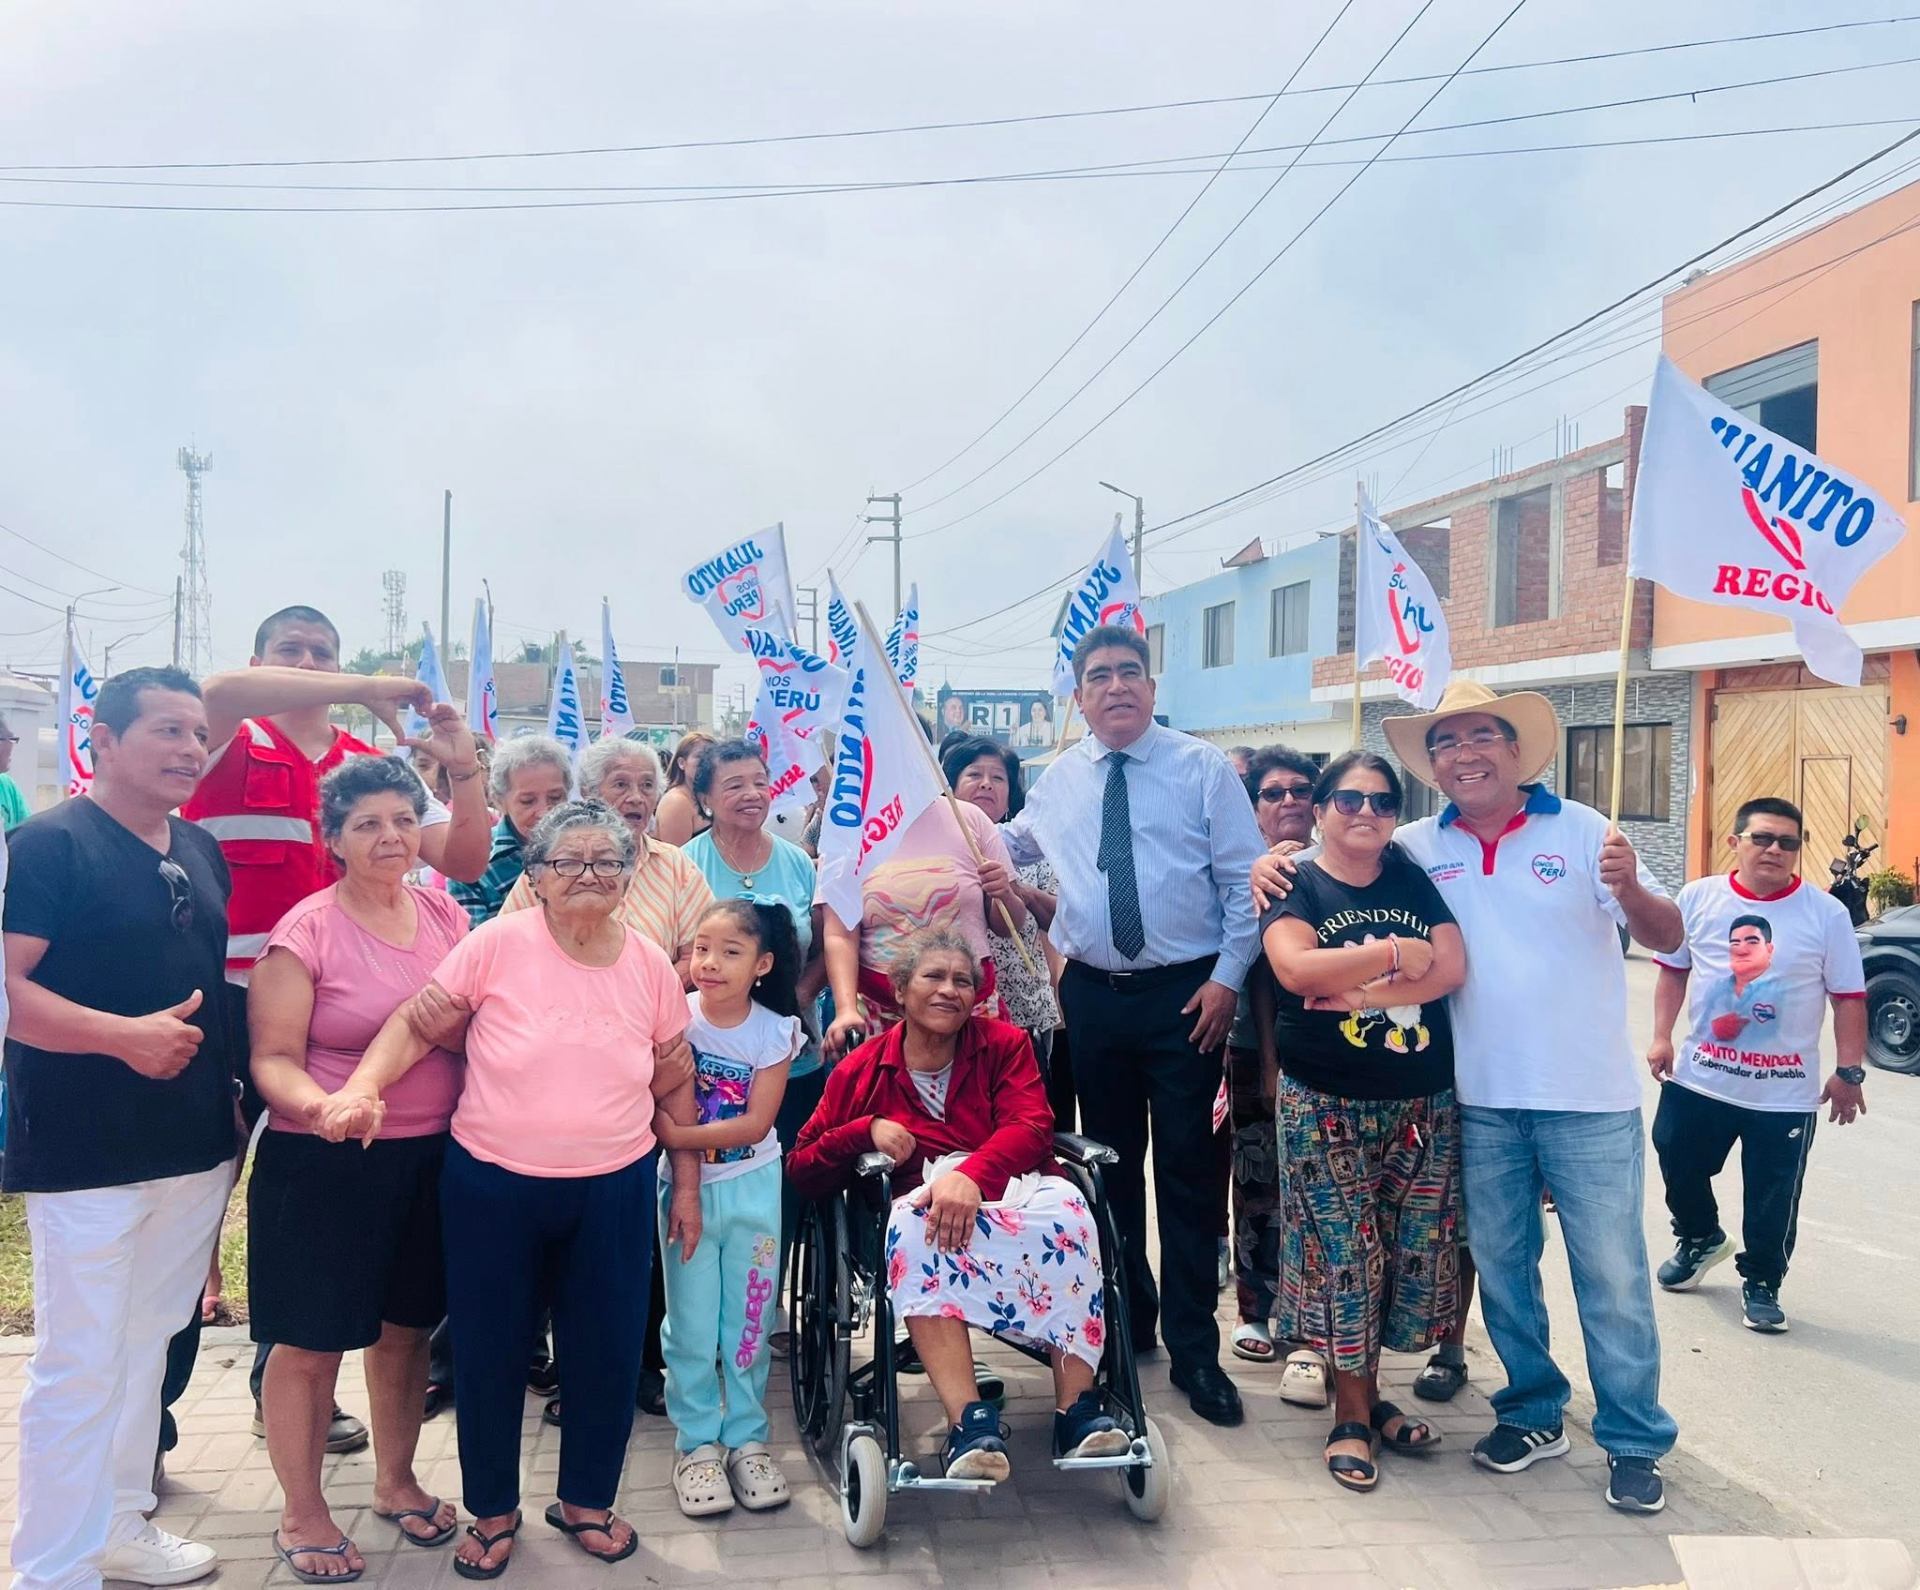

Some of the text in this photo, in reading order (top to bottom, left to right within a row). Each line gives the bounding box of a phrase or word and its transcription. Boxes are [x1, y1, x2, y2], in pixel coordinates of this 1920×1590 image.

[828, 599, 857, 662] JUANI
[1384, 655, 1425, 693] GIO
[769, 689, 820, 711] ERU
[972, 706, 1011, 726] R 1
[1539, 867, 1567, 878] PERU
[1770, 1068, 1806, 1079] Pueblo
[735, 1267, 773, 1369] Barbie
